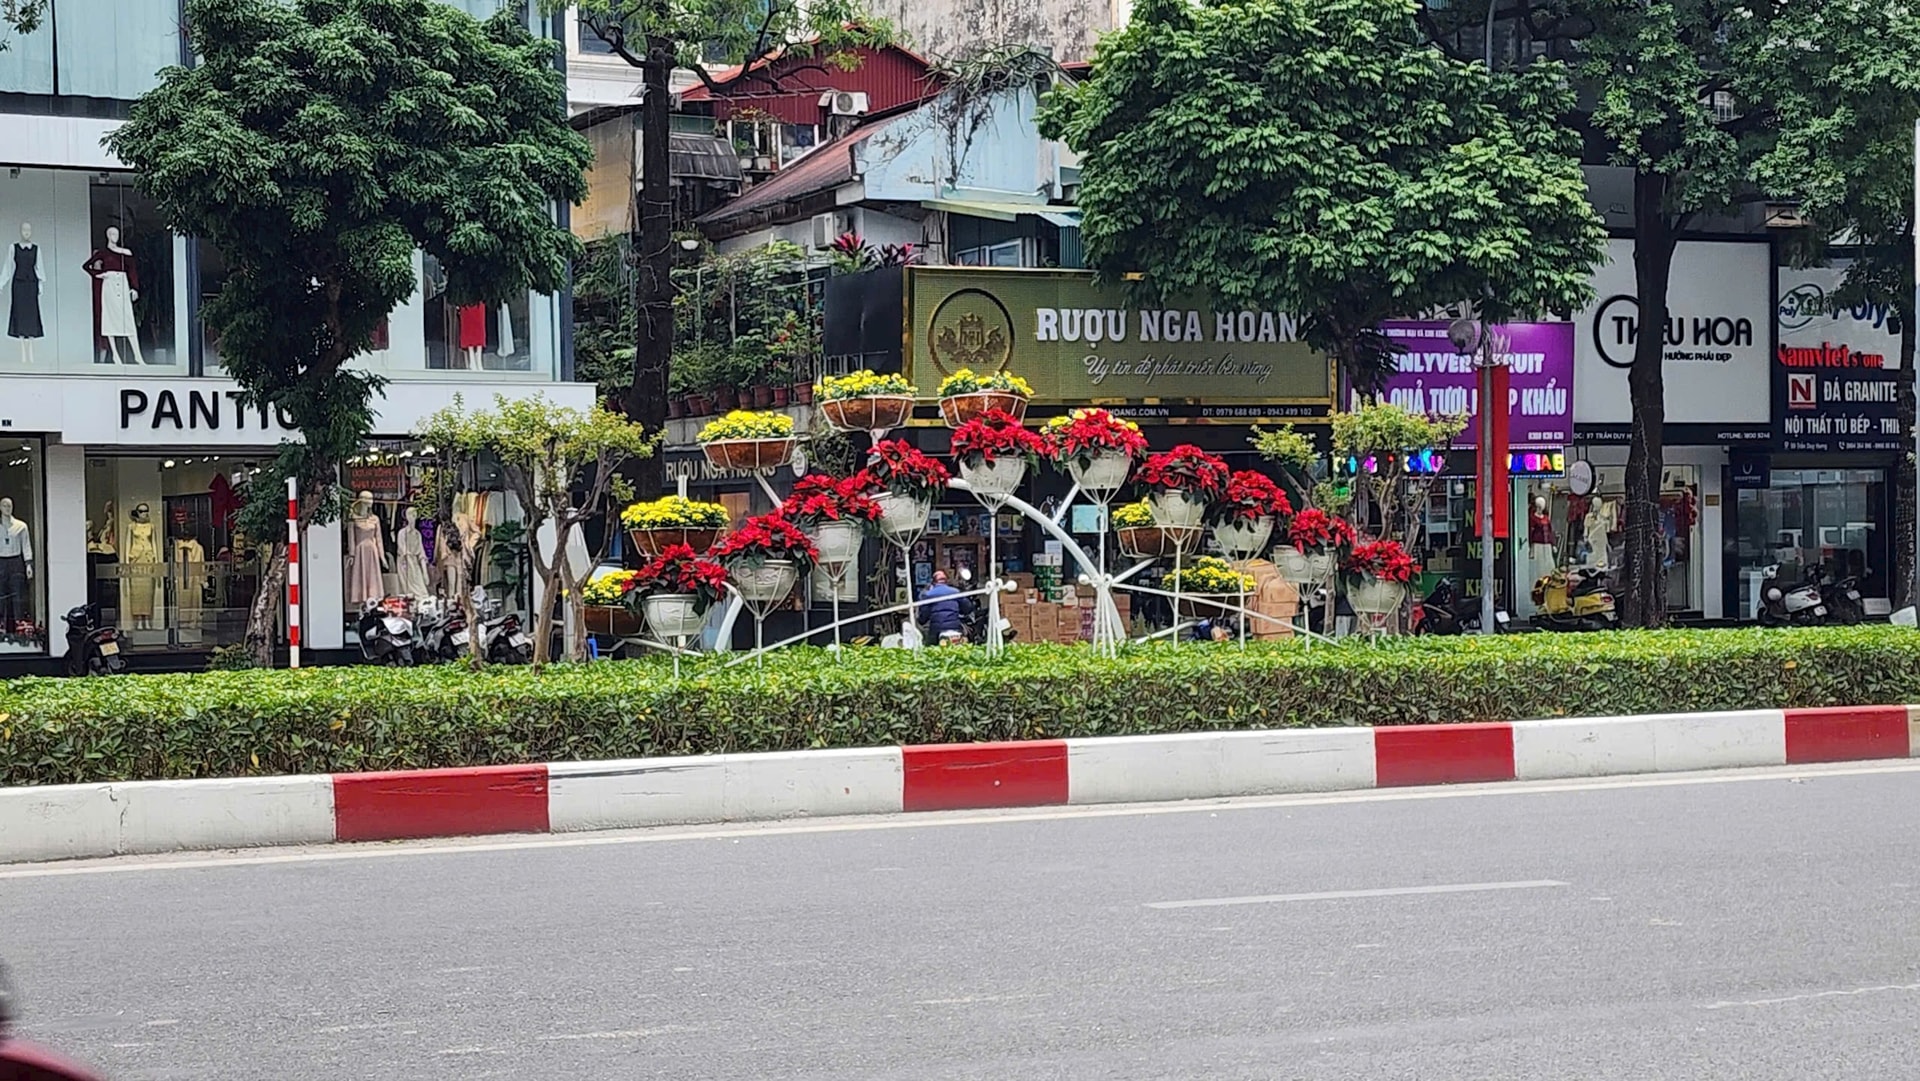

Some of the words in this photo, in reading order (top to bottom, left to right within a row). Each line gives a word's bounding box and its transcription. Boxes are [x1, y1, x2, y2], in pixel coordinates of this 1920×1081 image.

[1036, 308, 1127, 349] RƯỢU
[1140, 310, 1203, 342] NGA
[1215, 310, 1306, 342] HOAN
[1693, 317, 1753, 346] HOA
[1522, 377, 1567, 416] KHẨU
[1824, 376, 1841, 402] ĐÁ
[1845, 381, 1898, 402] GRANITE
[1785, 415, 1803, 438] NỘI
[1806, 412, 1832, 435] THẤT
[1850, 413, 1871, 435] BẾP
